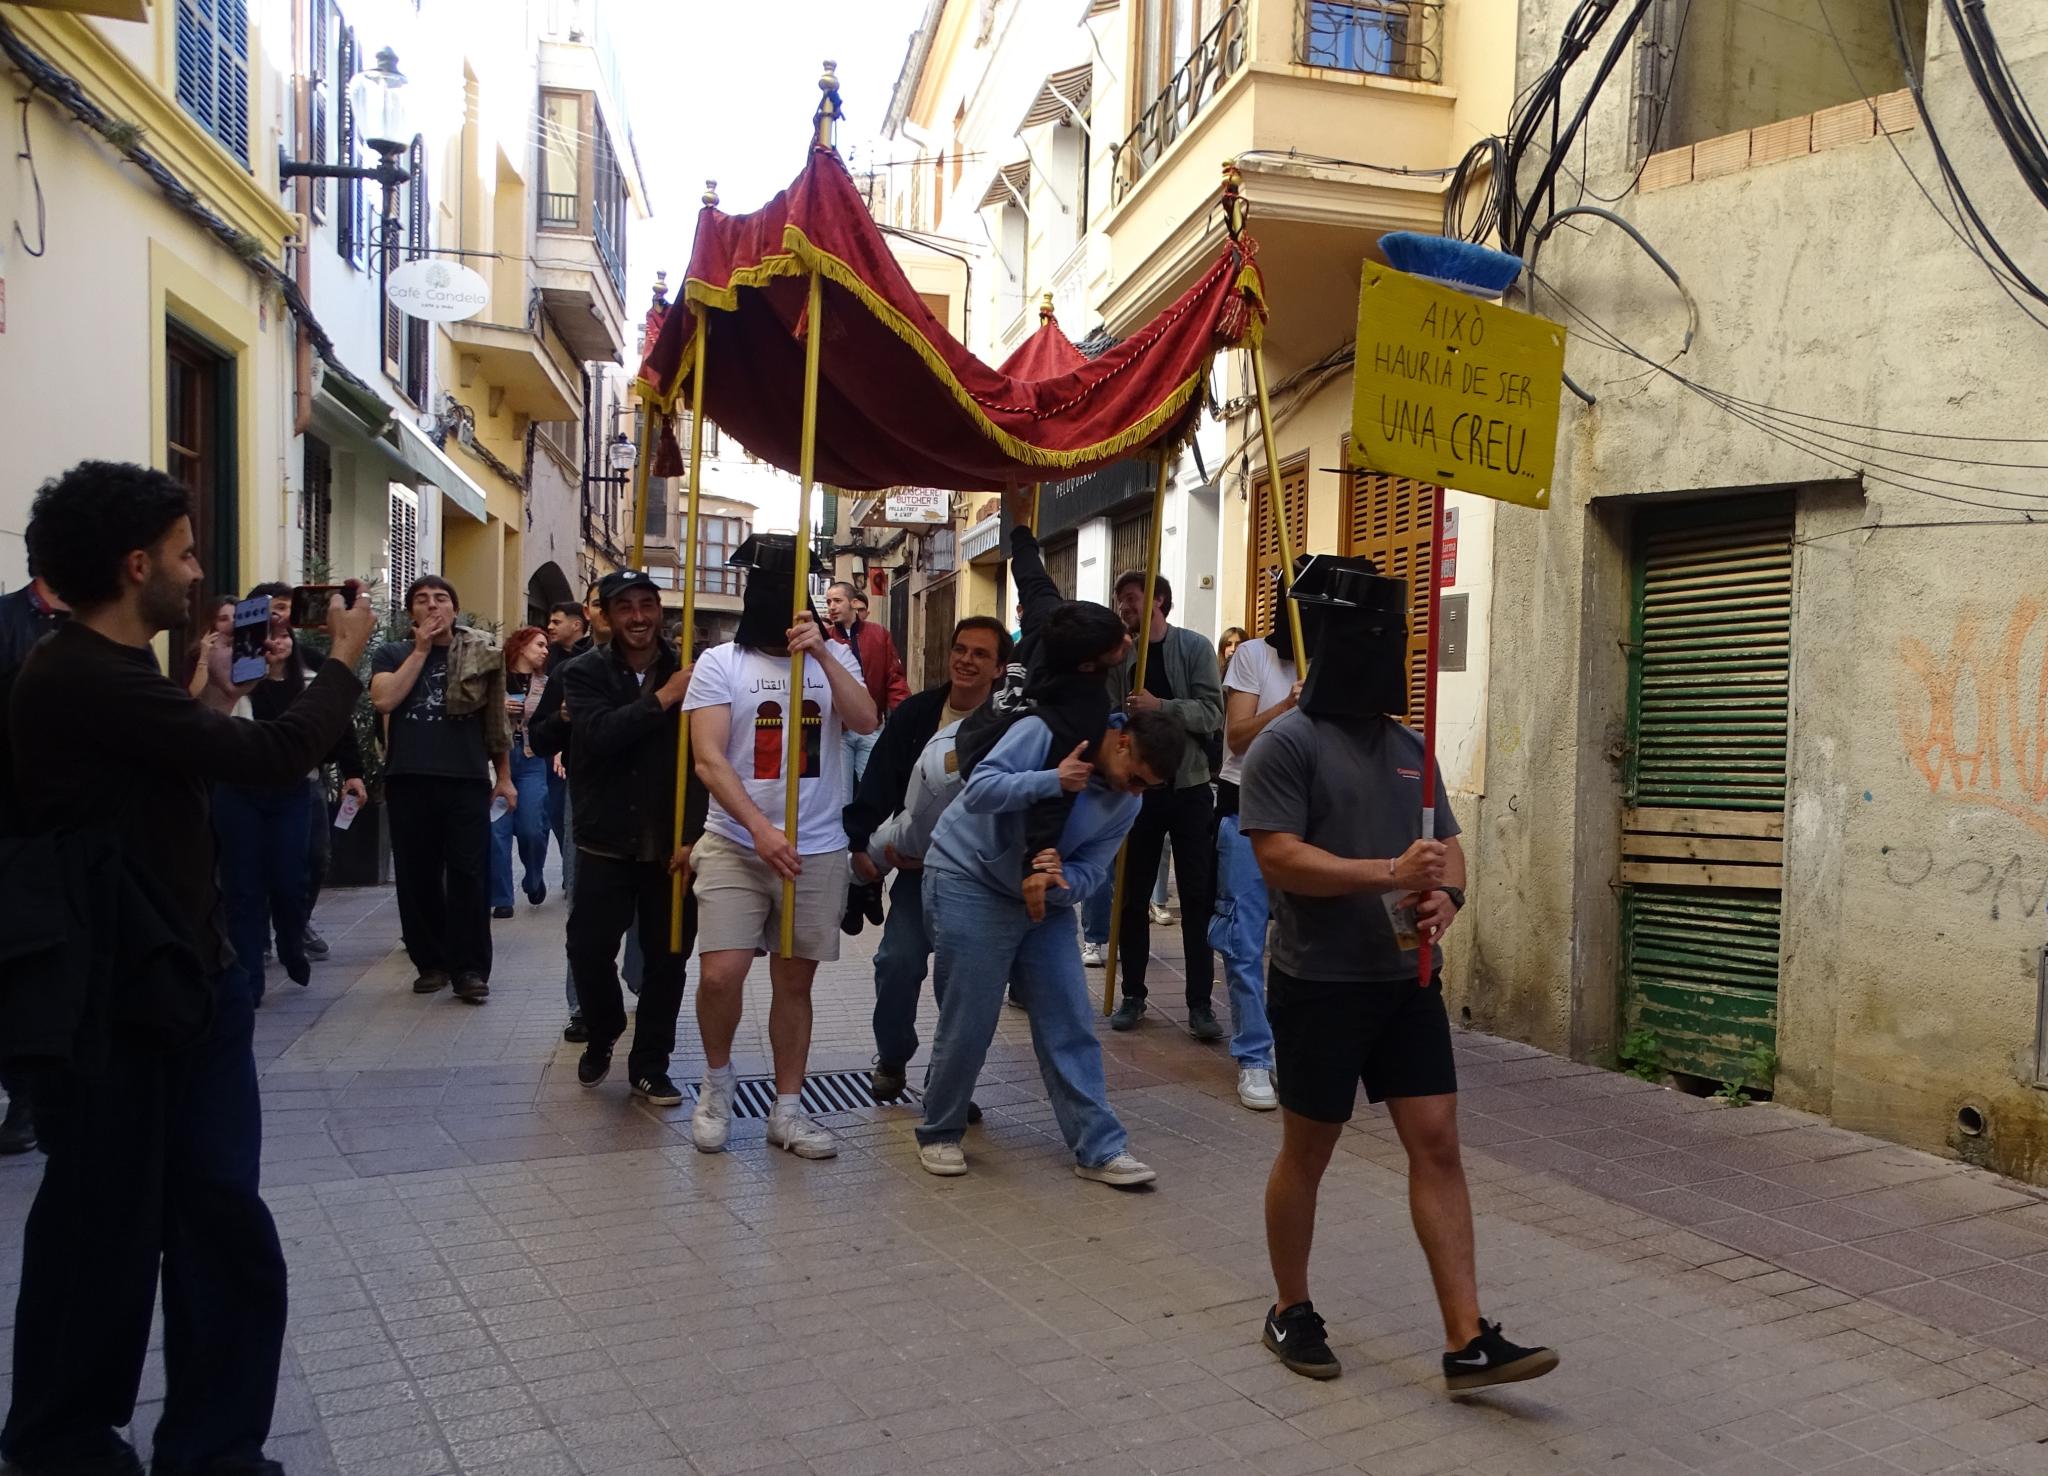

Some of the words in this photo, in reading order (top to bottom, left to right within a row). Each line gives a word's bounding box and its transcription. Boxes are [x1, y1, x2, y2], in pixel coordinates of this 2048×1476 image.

[426, 289, 486, 304] Candela
[1420, 301, 1484, 346] AIXÒ
[1375, 342, 1452, 387] HAURIA
[1462, 362, 1489, 396] DE
[1496, 372, 1532, 408] SER
[1382, 394, 1438, 453] UNA
[750, 678, 786, 694] القتال
